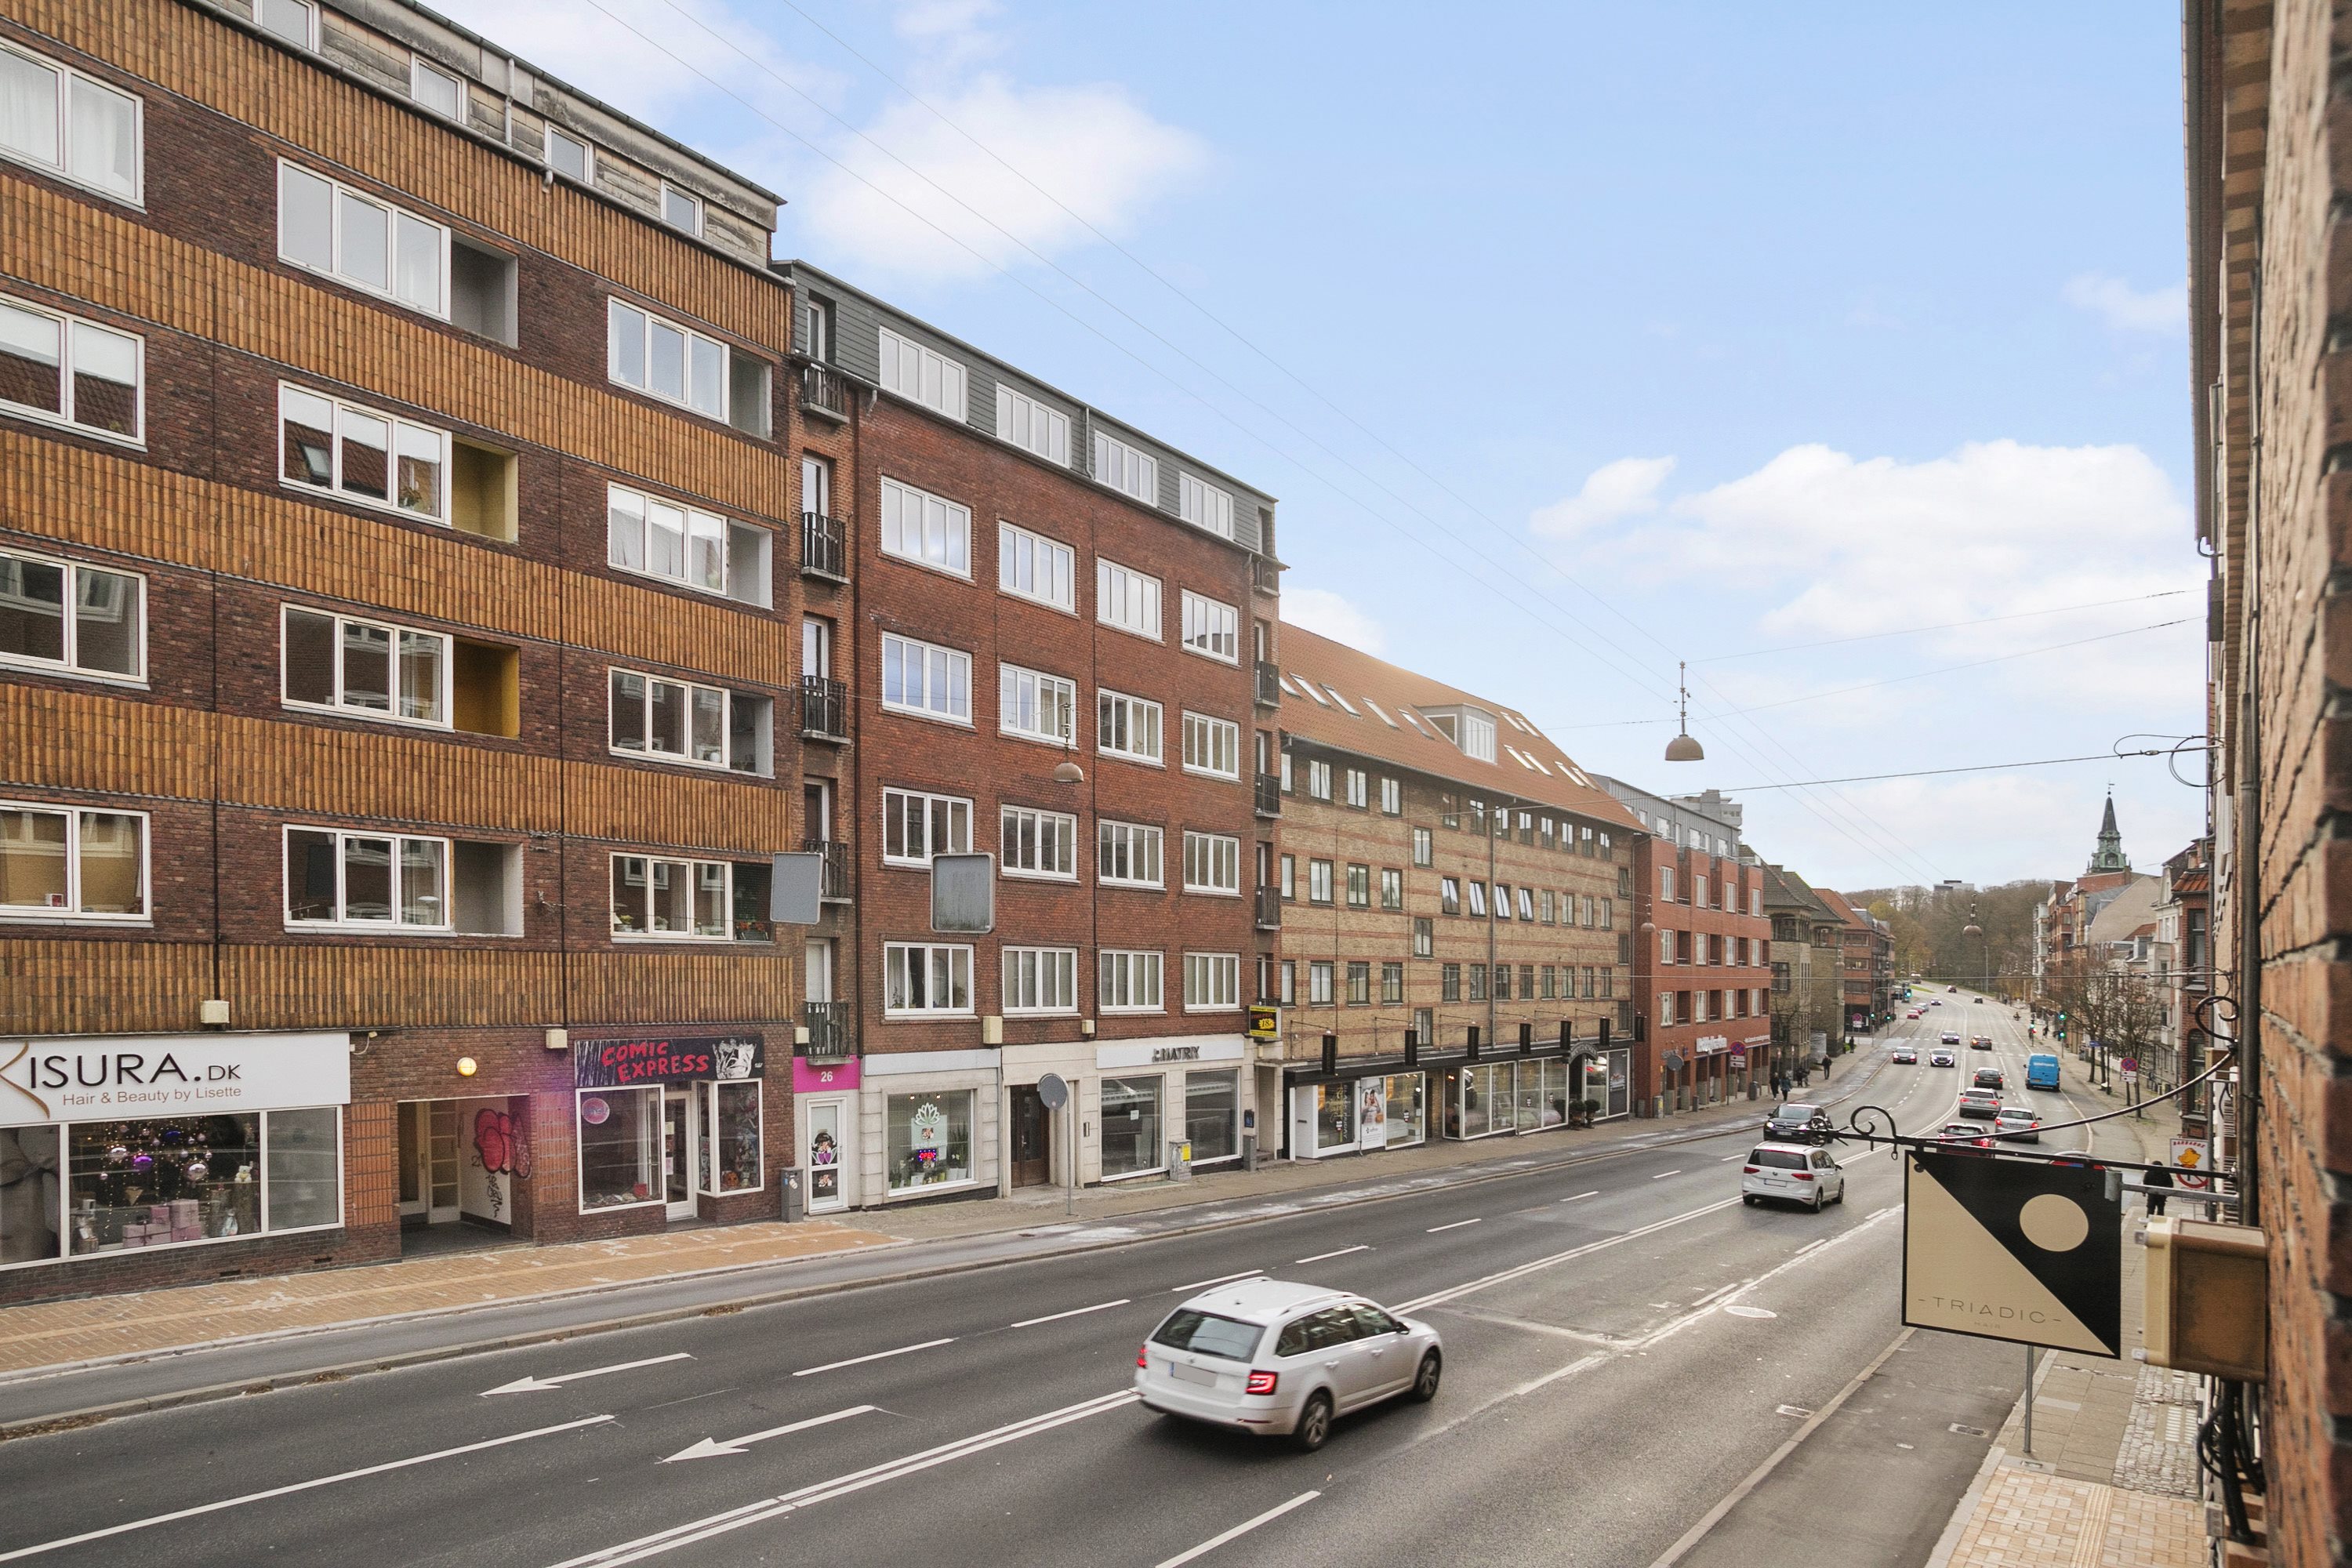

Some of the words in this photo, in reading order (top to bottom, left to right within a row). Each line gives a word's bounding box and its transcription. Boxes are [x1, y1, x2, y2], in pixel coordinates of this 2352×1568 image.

[601, 1041, 669, 1067] COMIC
[616, 1054, 710, 1083] EXPRESS
[821, 1071, 833, 1083] 26
[63, 1093, 95, 1106] Hair
[100, 1091, 111, 1104] &
[118, 1089, 169, 1104] Beauty
[174, 1088, 191, 1102] by
[196, 1086, 242, 1098] Lisette
